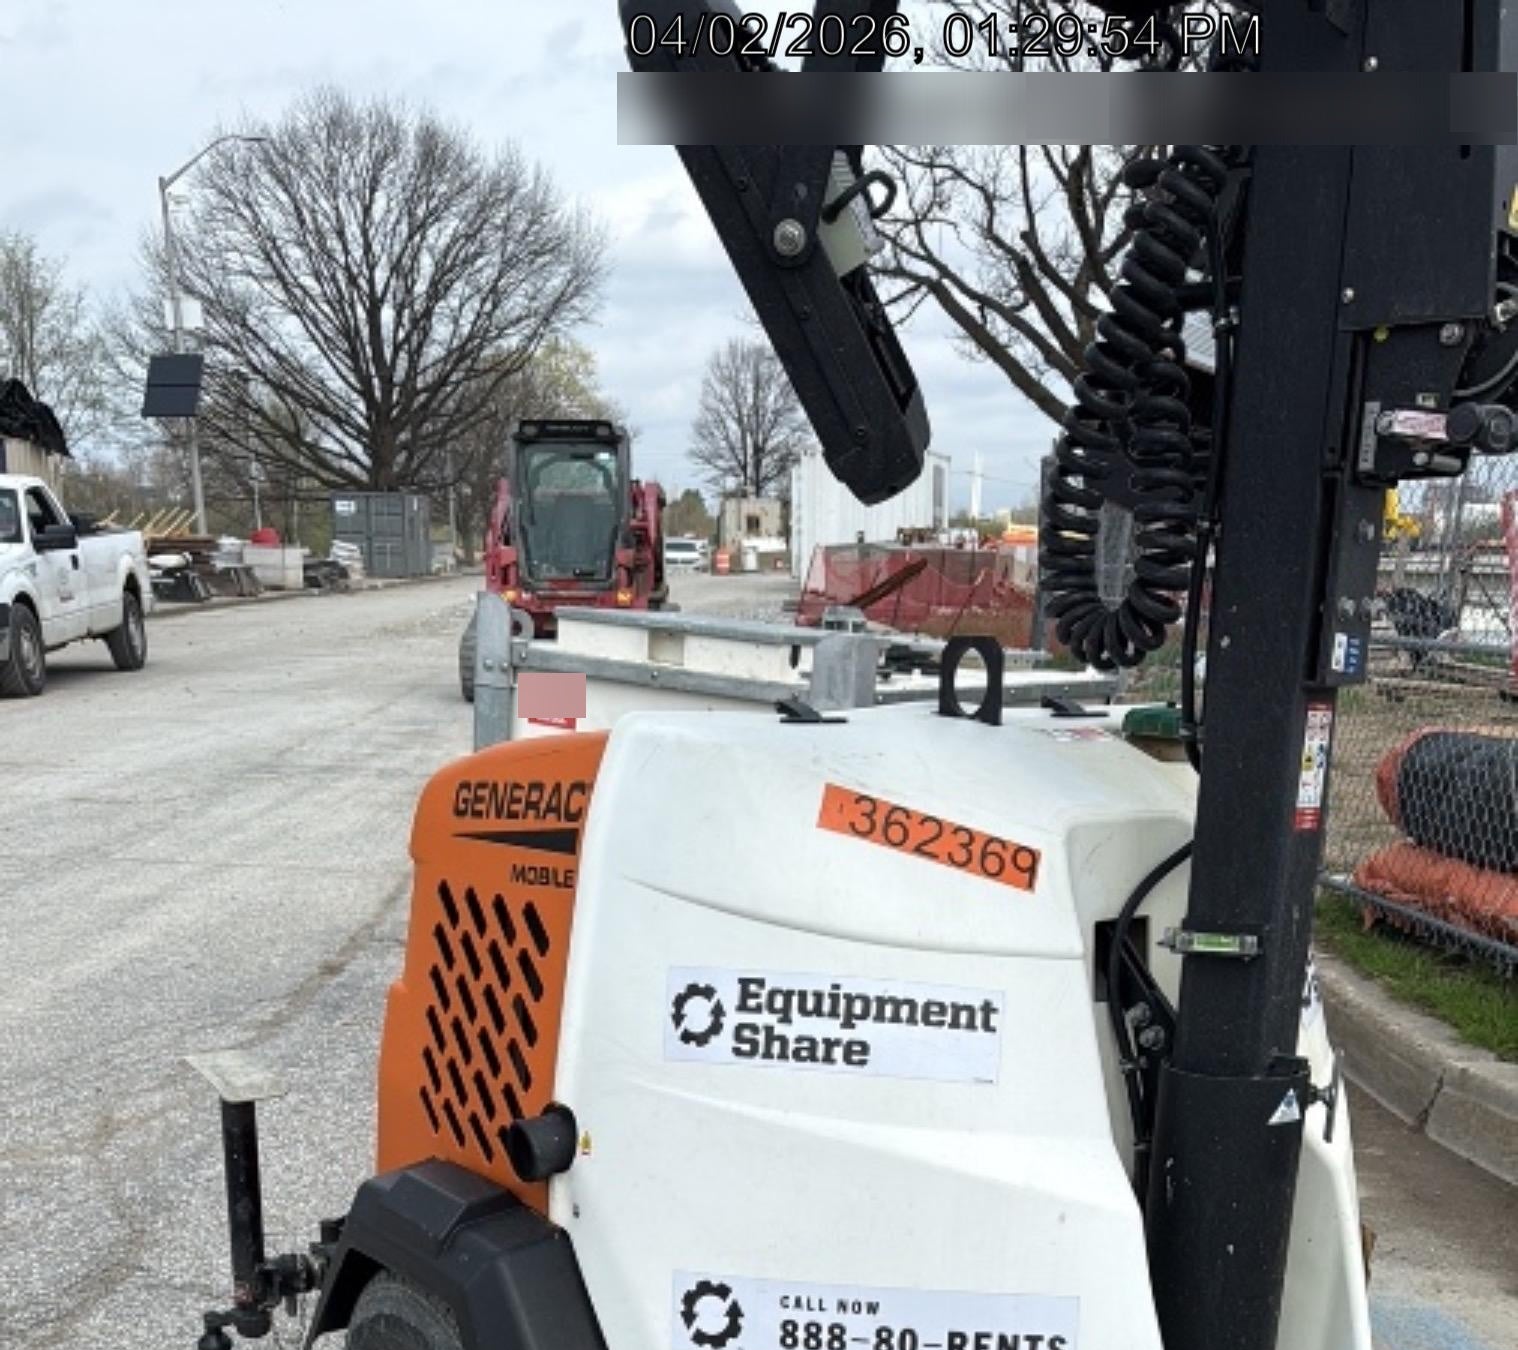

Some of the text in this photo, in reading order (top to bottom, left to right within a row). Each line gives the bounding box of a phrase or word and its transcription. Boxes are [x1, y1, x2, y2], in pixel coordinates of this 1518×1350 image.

[453, 780, 586, 822] GENERAC
[850, 795, 1038, 890] 362369
[510, 863, 575, 888] MOBILE
[735, 977, 998, 1033] Equipment
[731, 1022, 871, 1067] Share
[780, 1295, 880, 1315] CALL NOW
